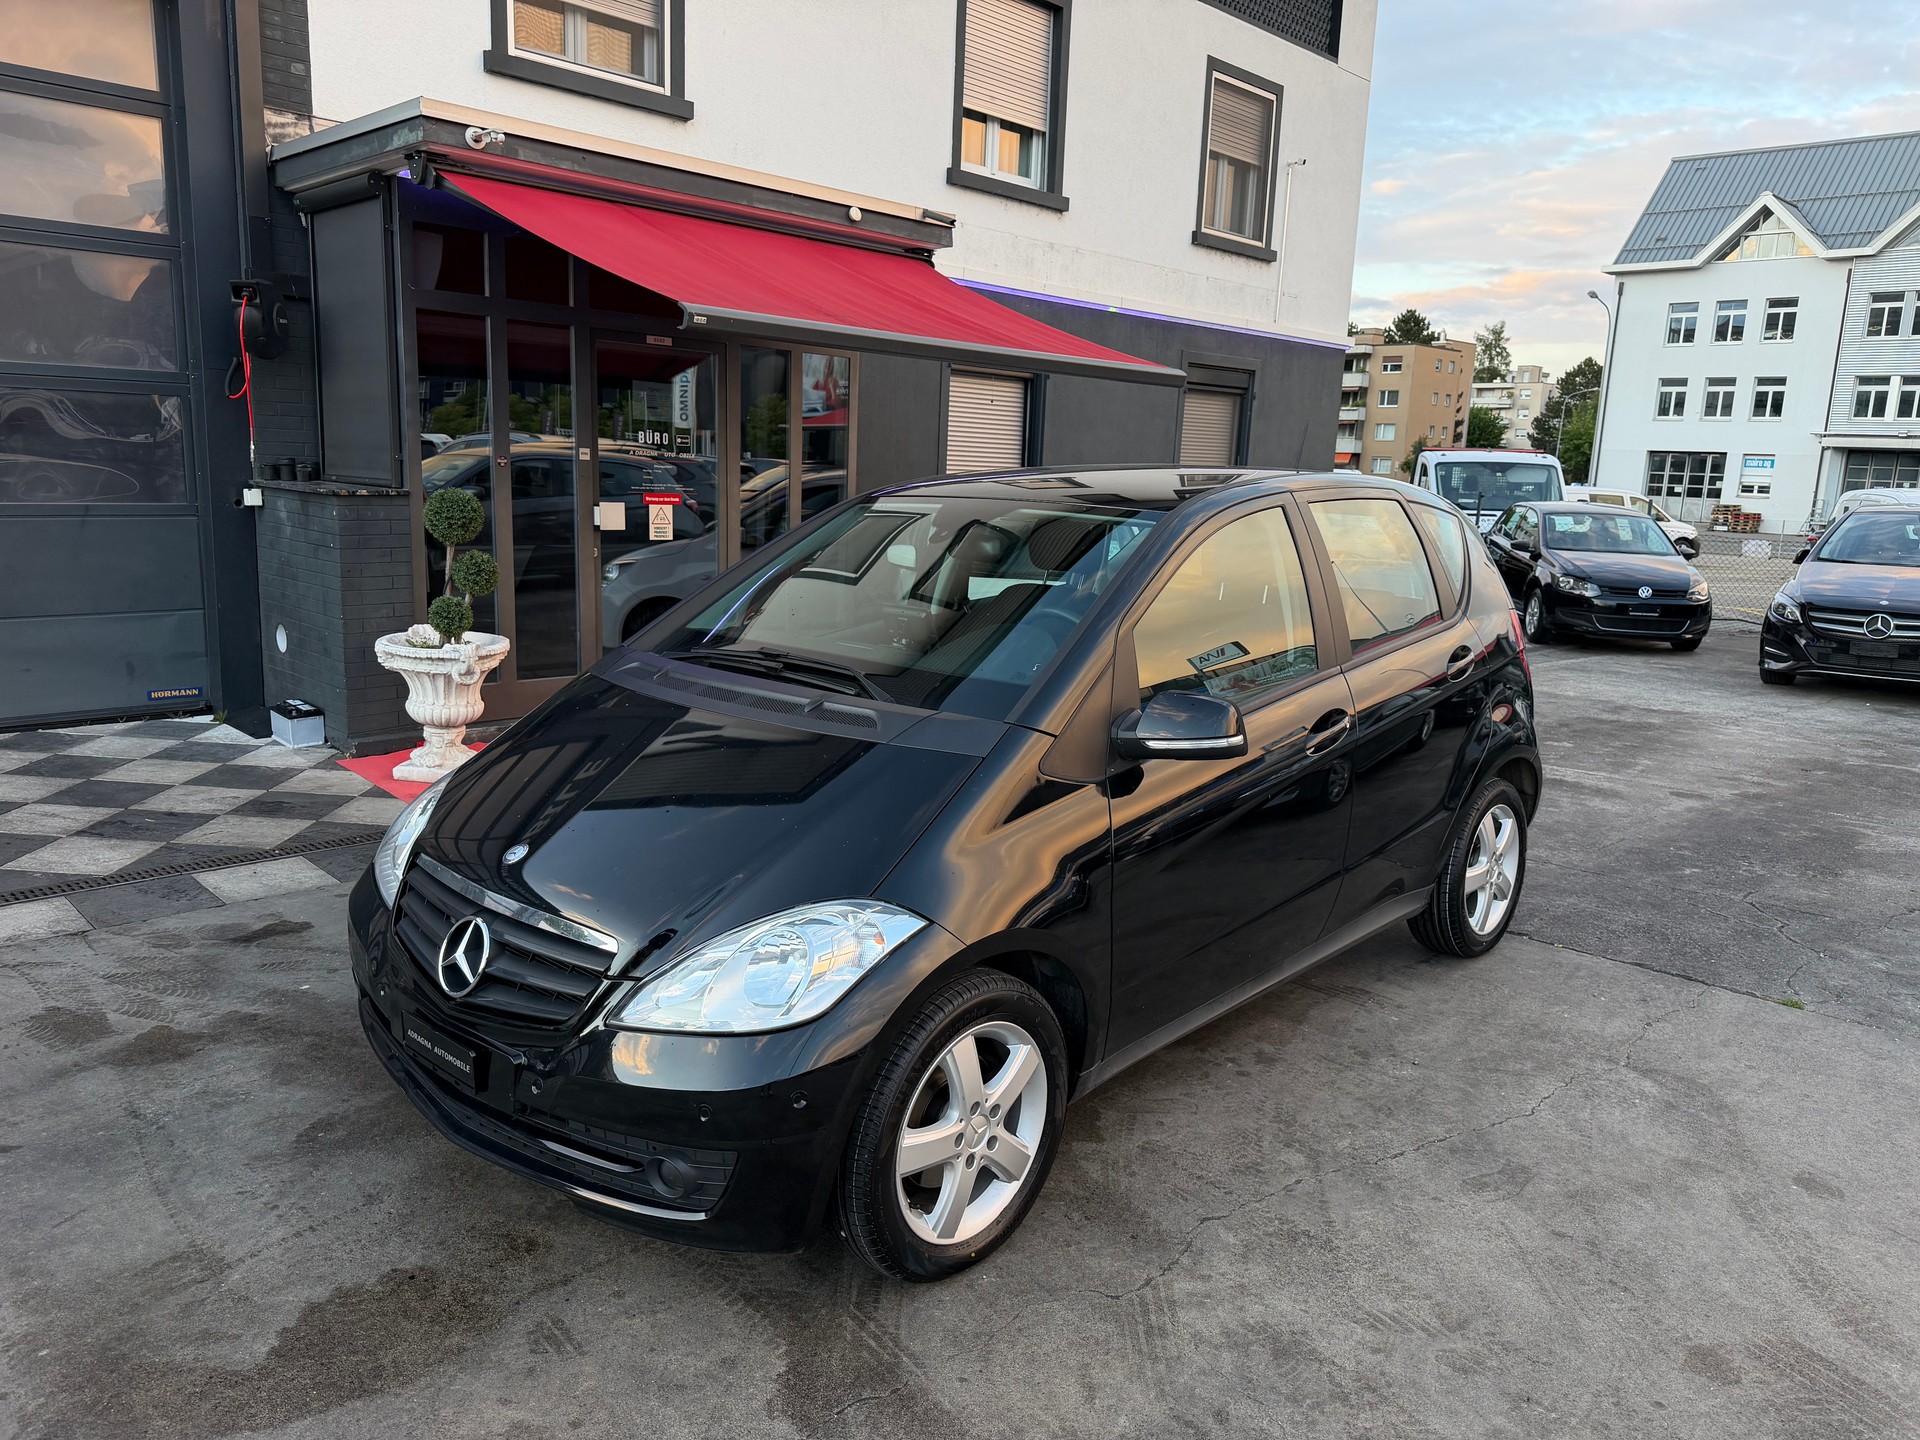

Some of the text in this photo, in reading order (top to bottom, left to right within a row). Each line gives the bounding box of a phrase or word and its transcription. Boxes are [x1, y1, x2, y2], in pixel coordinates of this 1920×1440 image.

[638, 429, 669, 445] BÜRO
[407, 1028, 471, 1073] ADRAGNA AUTOMOBILE
